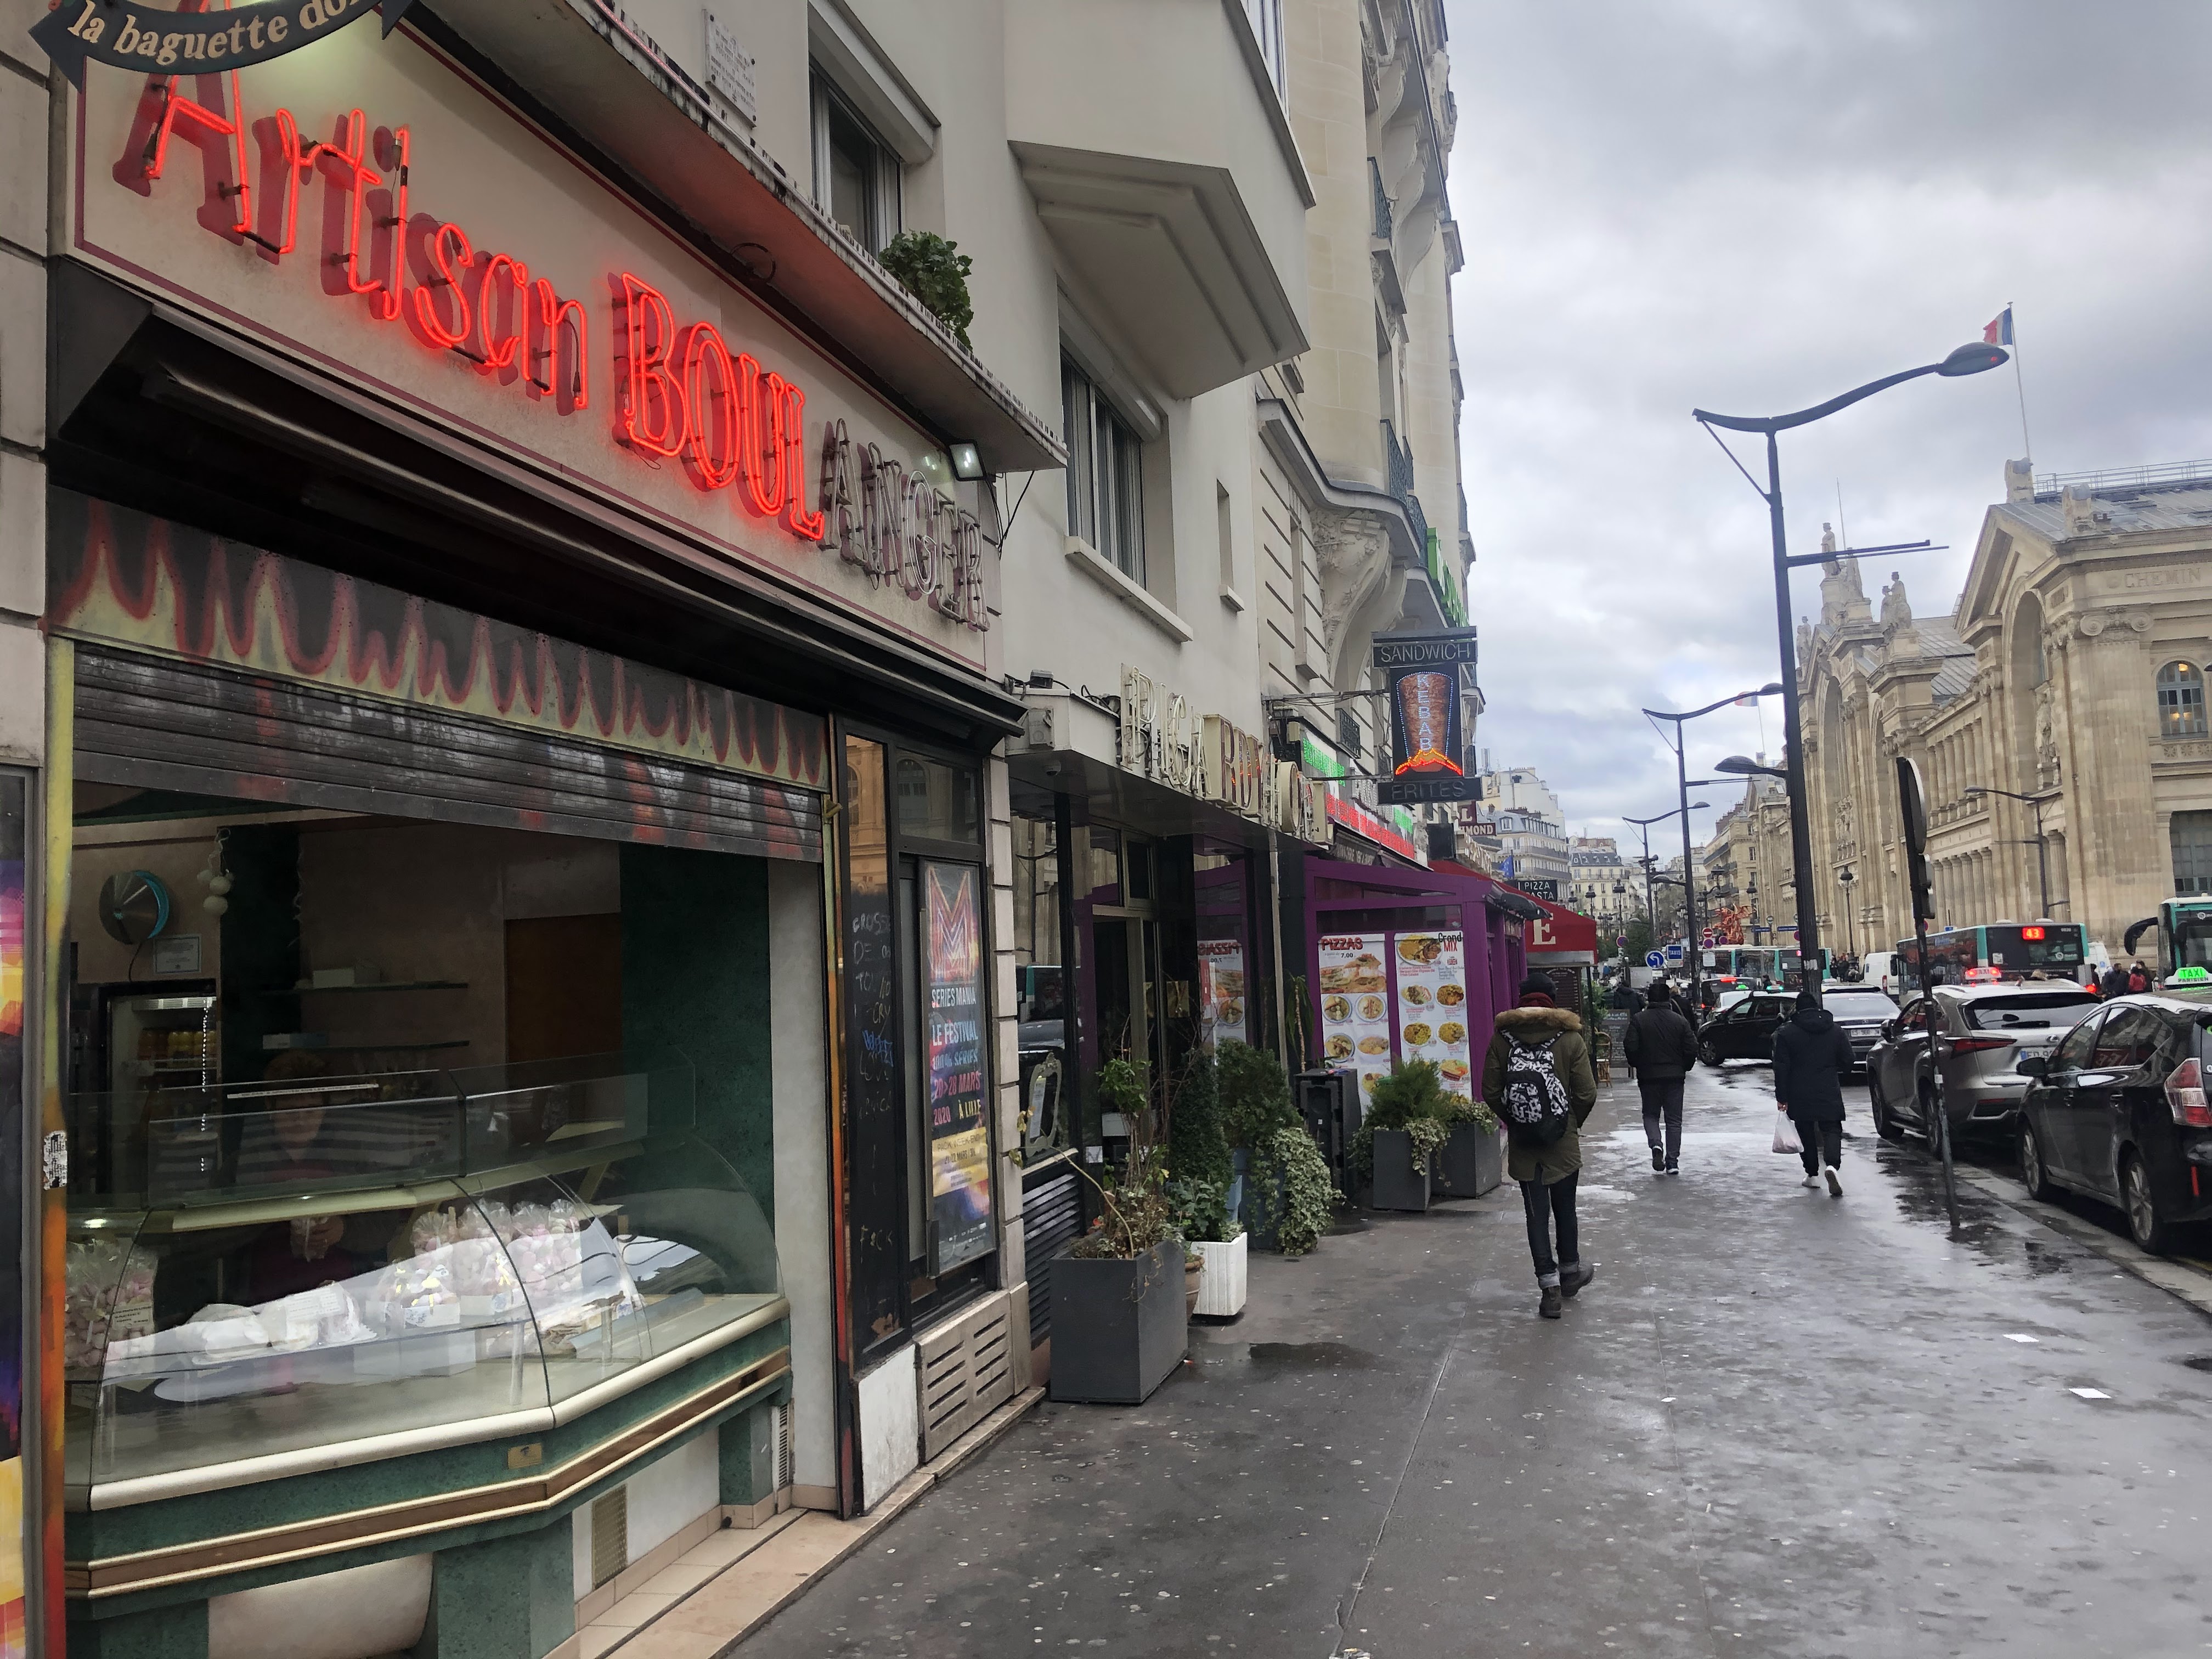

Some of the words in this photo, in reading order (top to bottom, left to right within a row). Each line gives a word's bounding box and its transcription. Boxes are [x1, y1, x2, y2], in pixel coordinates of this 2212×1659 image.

[67, 0, 106, 43] la
[113, 14, 289, 65] baguette
[299, 0, 360, 30] do
[112, 0, 588, 416] Artisan
[608, 272, 990, 632] BOULANGER
[2124, 567, 2202, 588] CHEMIN
[1380, 643, 1470, 663] SANDWICH
[1417, 673, 1432, 751] KEBAB
[1524, 882, 1550, 890] PIZZA
[1321, 936, 1363, 951] PIZZAS
[1438, 932, 1462, 943] Grand
[2025, 928, 2040, 938] 43
[1443, 941, 1458, 952] MIX
[2181, 968, 2204, 978] TAXI
[932, 988, 955, 1008] SERIES
[956, 986, 977, 1006] MANIA
[932, 1023, 943, 1047] LE
[944, 1020, 979, 1045] FESTIVAL
[958, 1070, 981, 1094] MARS
[934, 1105, 951, 1125] 2020
[964, 1099, 981, 1119] LILLE
